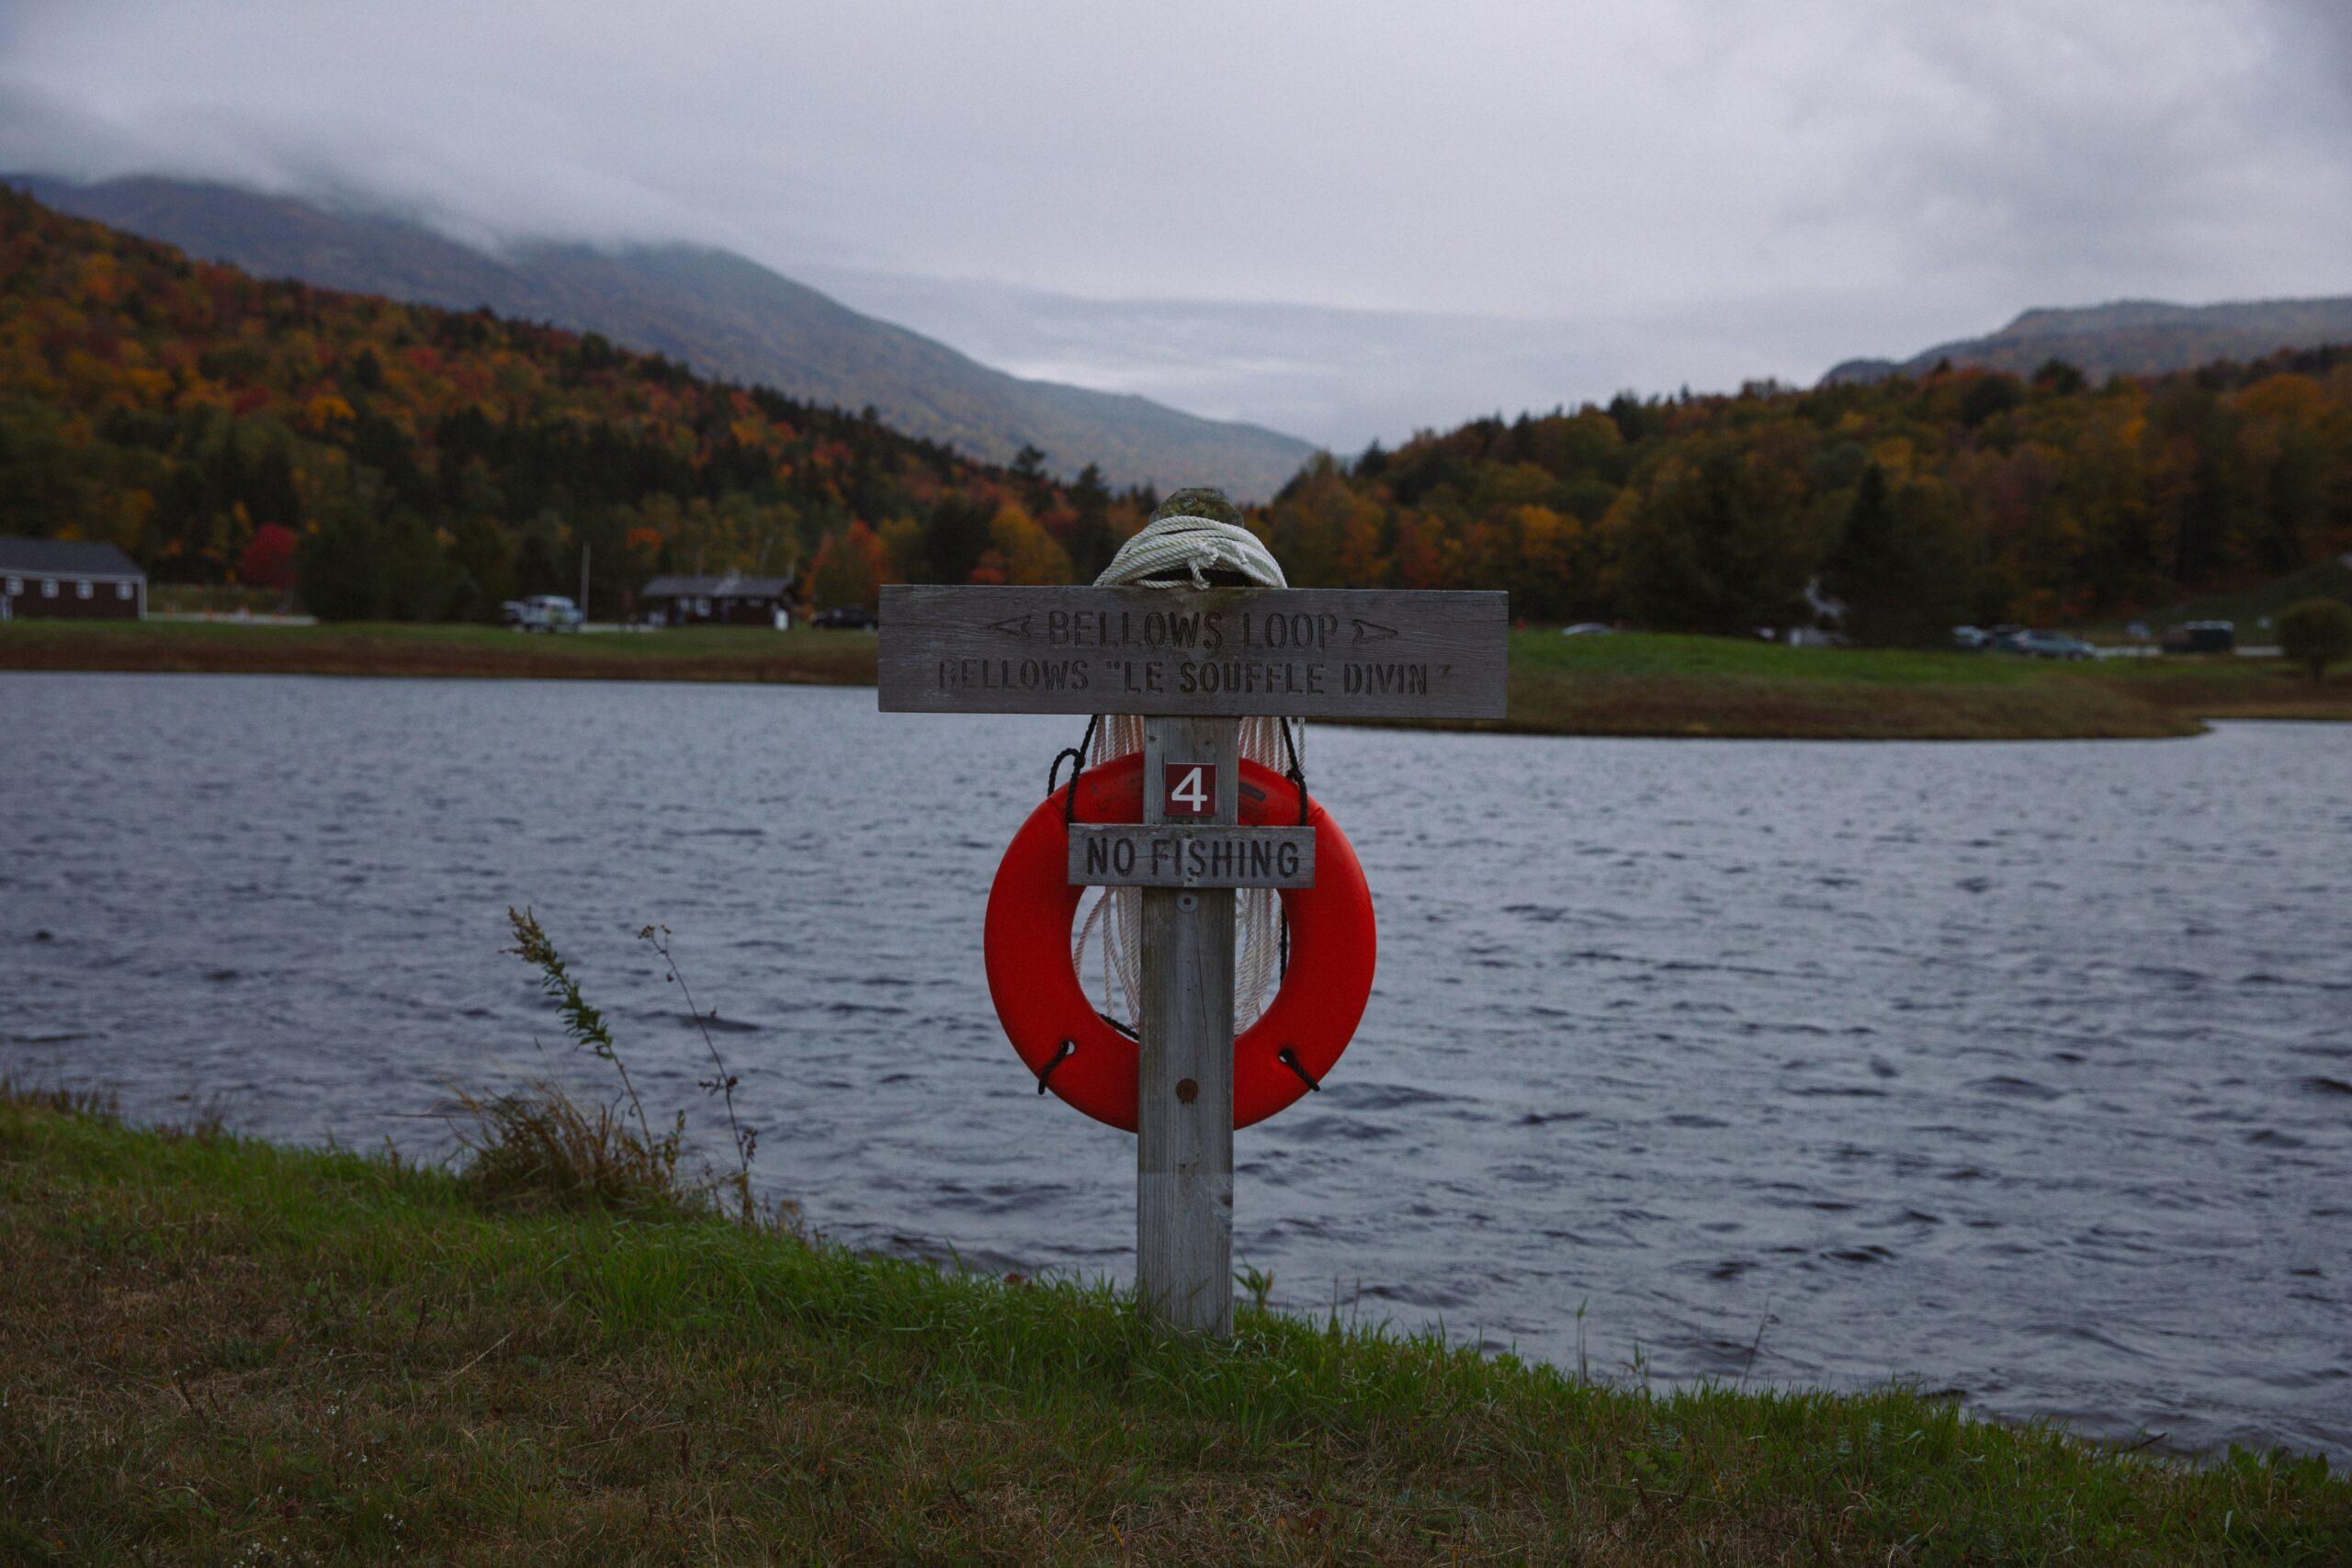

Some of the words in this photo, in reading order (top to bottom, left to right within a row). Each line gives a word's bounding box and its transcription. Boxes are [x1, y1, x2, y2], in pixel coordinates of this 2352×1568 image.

[1049, 610, 1222, 649] BELLOWS
[1243, 613, 1338, 649] LOOP
[939, 660, 1089, 691] BELLOWS
[1180, 661, 1324, 694] SOUFFLE
[1171, 767, 1207, 812] 4
[1087, 837, 1136, 876] NO
[1151, 839, 1299, 879] FISHING
